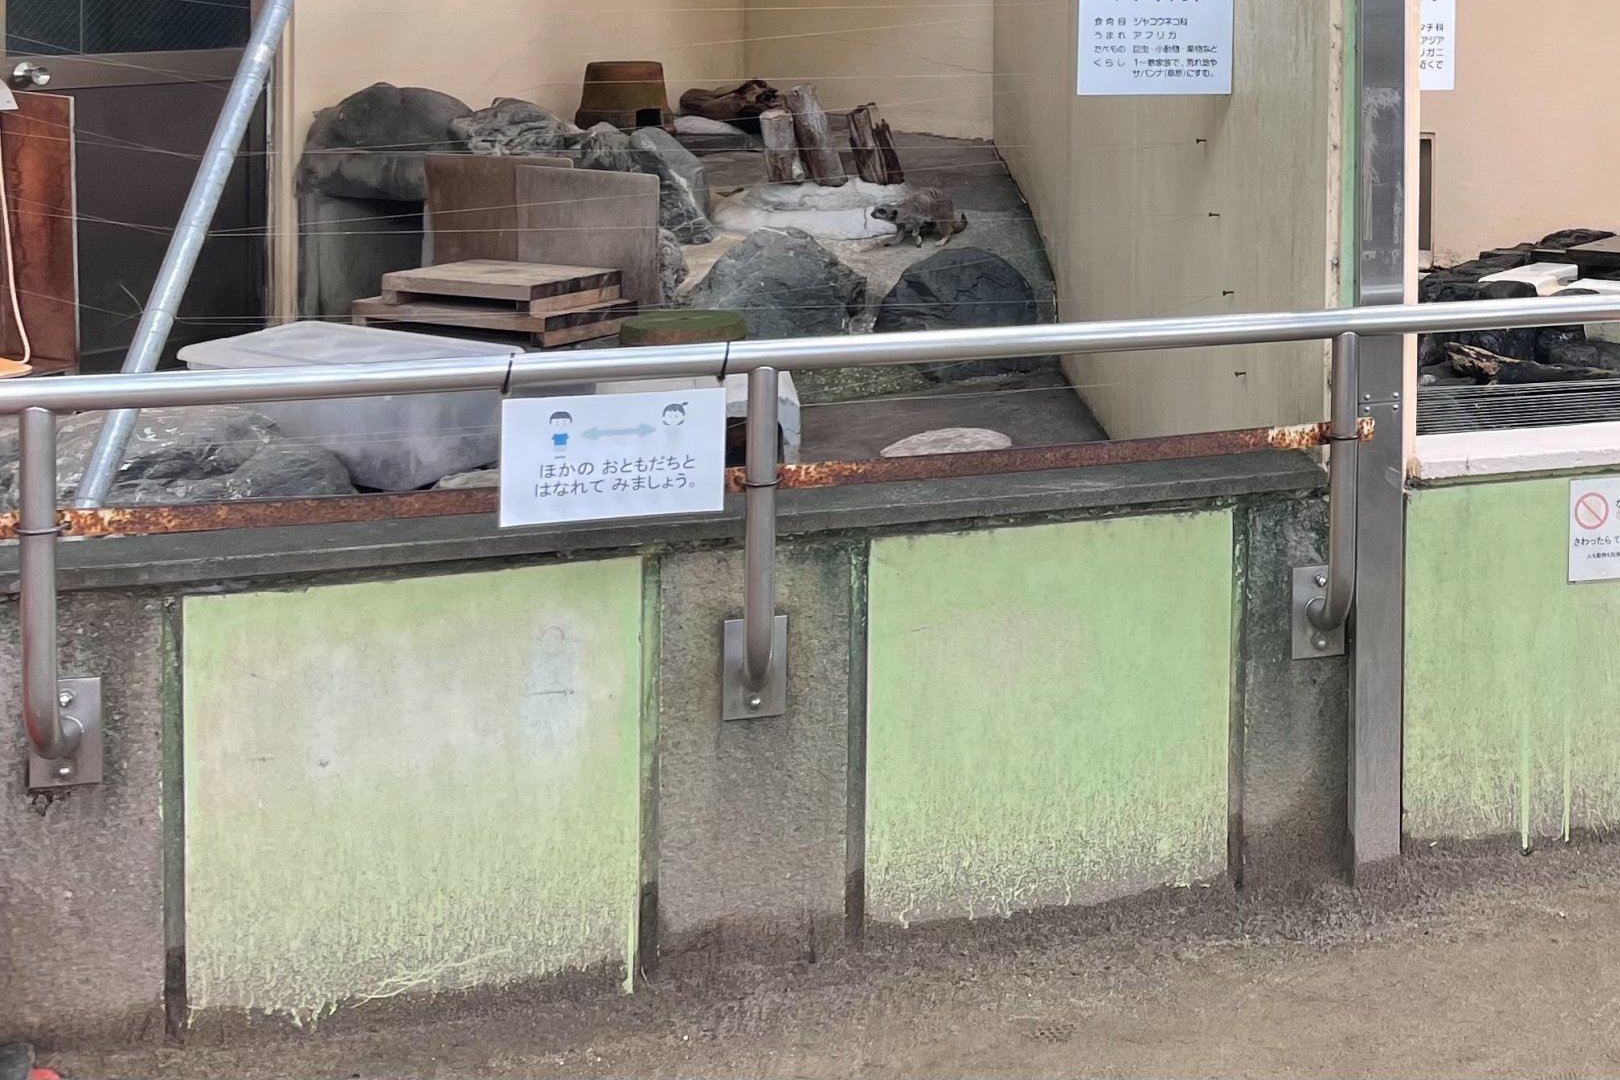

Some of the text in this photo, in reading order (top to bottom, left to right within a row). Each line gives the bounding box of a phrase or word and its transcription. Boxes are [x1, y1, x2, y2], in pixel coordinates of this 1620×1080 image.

[1133, 31, 1177, 40] アフリカ
[1093, 58, 1126, 67] くらし
[540, 454, 696, 479] ほかの おともだちと
[534, 472, 697, 498] はなれて みましょう。
[1573, 536, 1612, 547] さわったら
